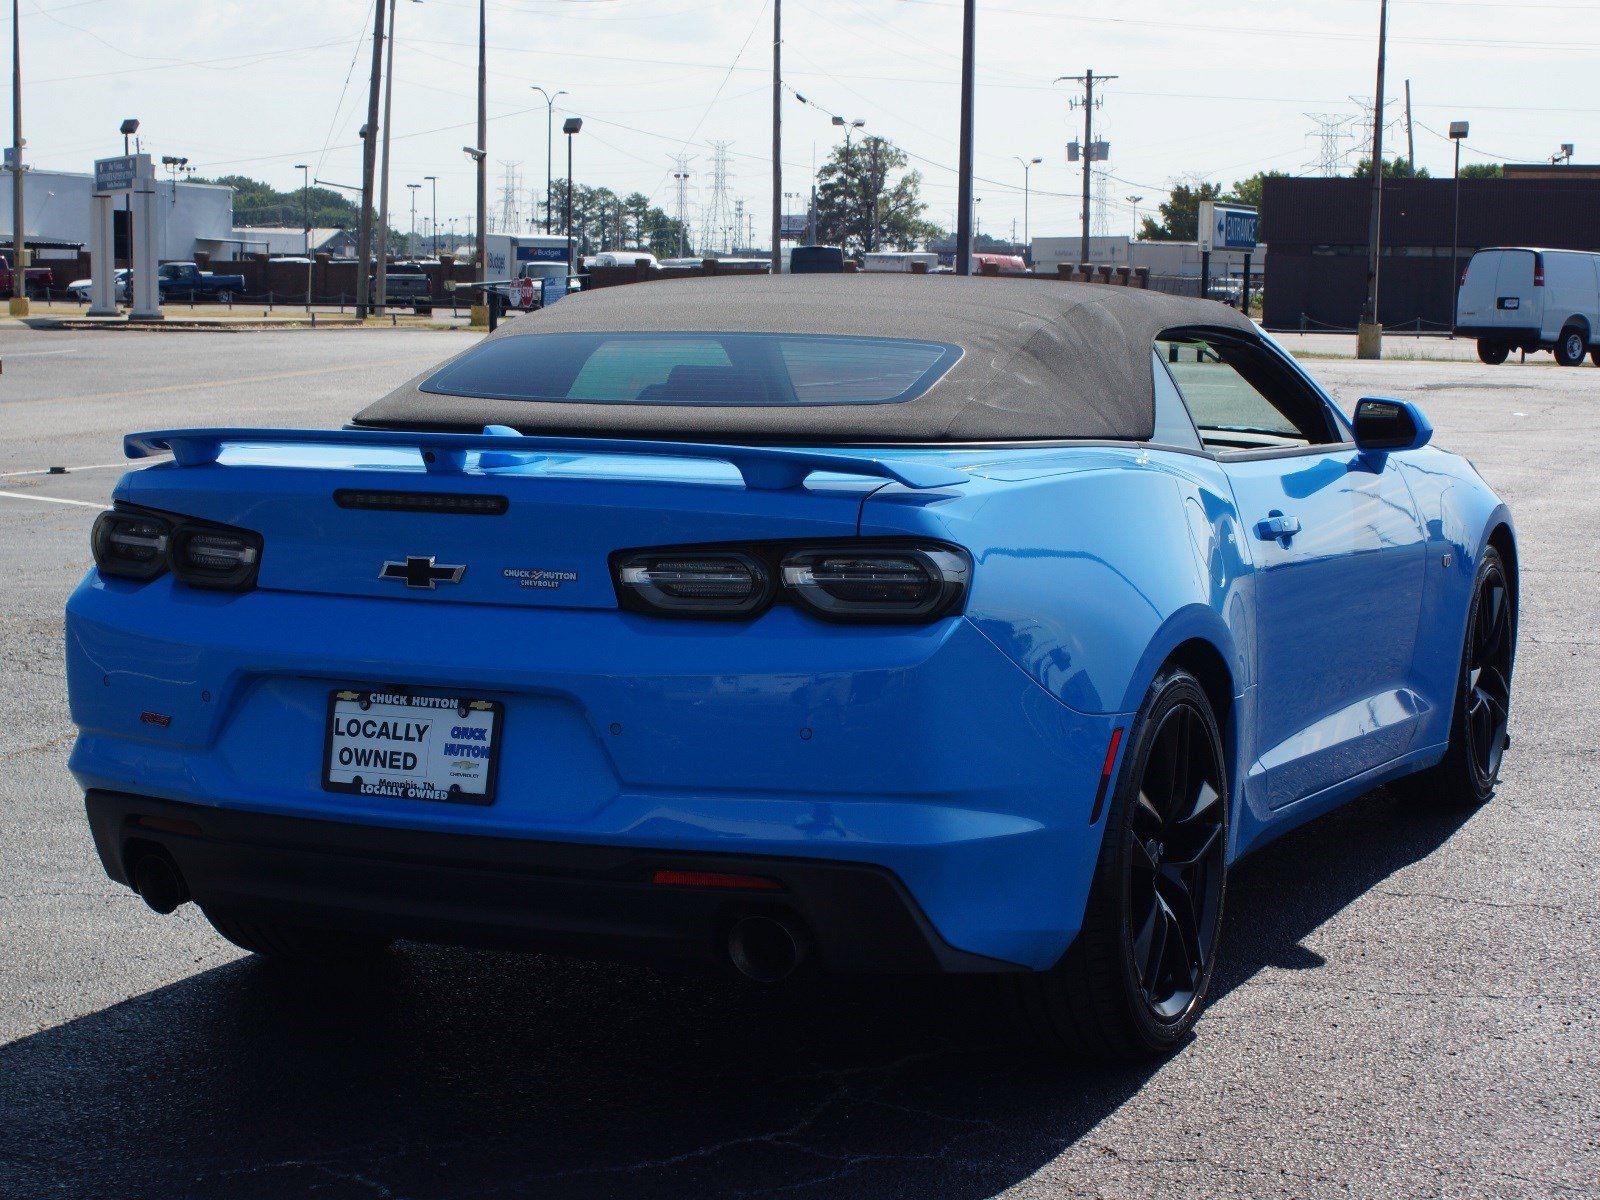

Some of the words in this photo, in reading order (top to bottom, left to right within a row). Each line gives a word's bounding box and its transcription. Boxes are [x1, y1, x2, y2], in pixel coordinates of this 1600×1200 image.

[1226, 216, 1256, 242] ENTRANCE
[537, 249, 561, 258] Budget
[522, 286, 533, 298] STOP
[503, 569, 530, 578] CHUCK
[543, 572, 577, 580] HUTTON
[520, 580, 559, 588] CHEVROLET
[369, 693, 408, 706] CHUCK
[412, 696, 459, 709] HUTTON
[334, 717, 430, 743] LOCALLY
[450, 726, 488, 742] CHUCK
[338, 746, 418, 771] OWNED
[443, 743, 491, 759] HUTTON
[360, 784, 404, 797] LOCALLY
[407, 788, 449, 800] OWNED
[422, 781, 435, 791] TN
